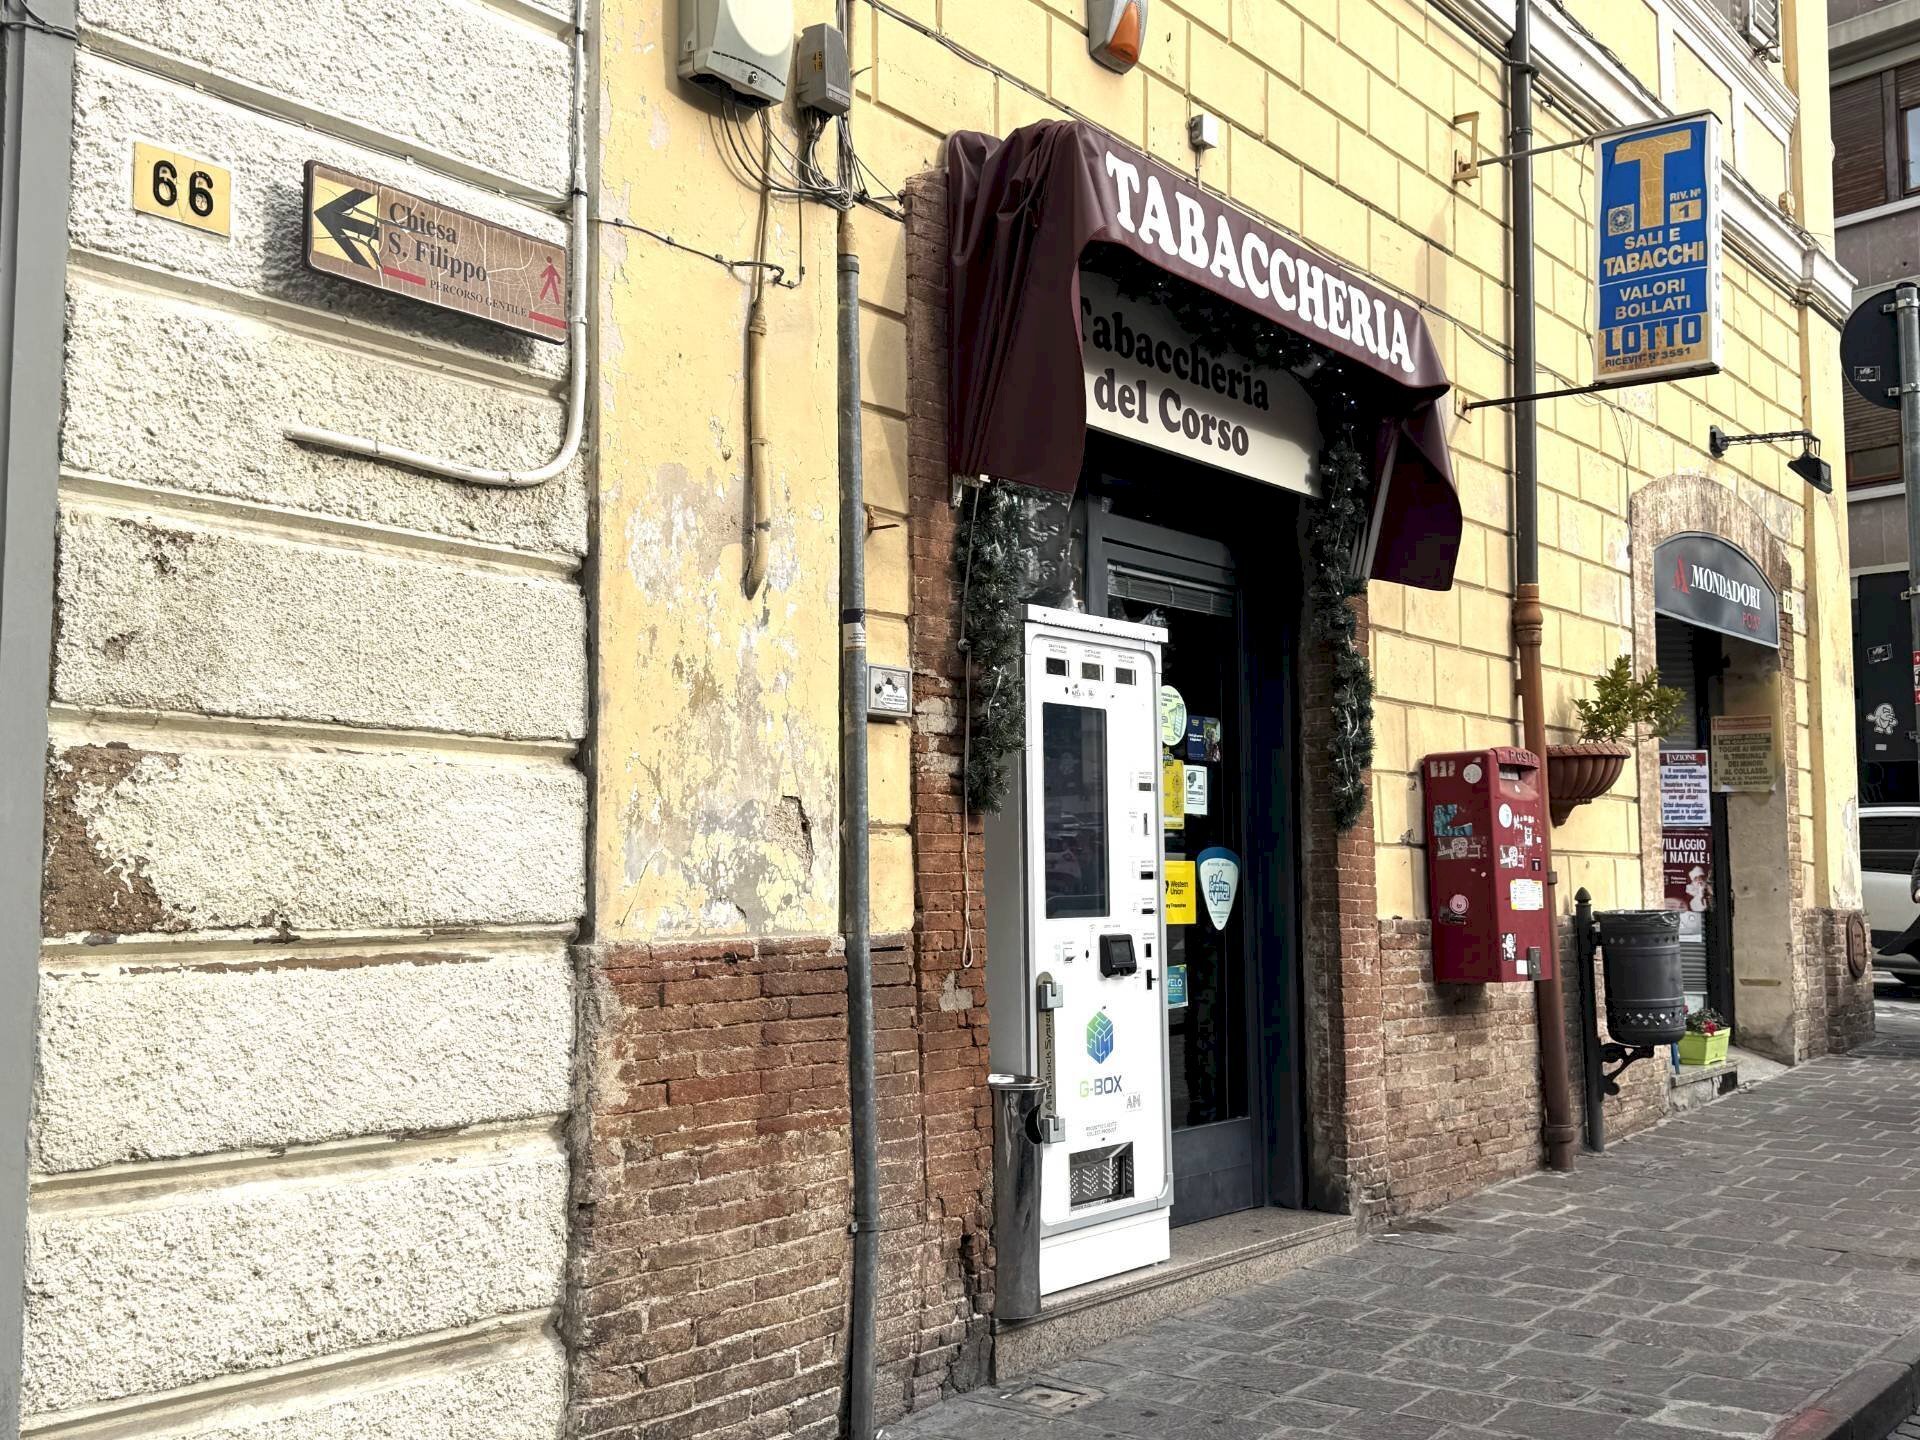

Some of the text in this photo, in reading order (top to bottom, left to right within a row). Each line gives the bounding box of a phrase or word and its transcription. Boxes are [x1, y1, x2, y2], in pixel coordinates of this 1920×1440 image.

[153, 160, 213, 217] 66
[1615, 129, 1691, 230] T
[389, 202, 457, 244] Chiesa
[1679, 204, 1690, 218] 1
[388, 231, 487, 283] S. Filippo
[1624, 228, 1681, 250] SALI E
[1105, 150, 1416, 373] TABACCHERIA
[1603, 241, 1704, 277] TABACCHI
[430, 280, 528, 317] PERCORSO GENTILE
[1615, 295, 1691, 320] BOLLATI
[1620, 278, 1686, 301] VALORI
[1081, 296, 1269, 411] Tabaccheria
[1605, 314, 1702, 358] LOTTO
[1094, 368, 1249, 456] del Corso
[1690, 564, 1761, 610] MONDADORI
[1662, 838, 1706, 851] VILLAGGIO
[1170, 880, 1189, 888] Western
[1170, 887, 1184, 896] Union
[1079, 1075, 1123, 1098] G-BOX
